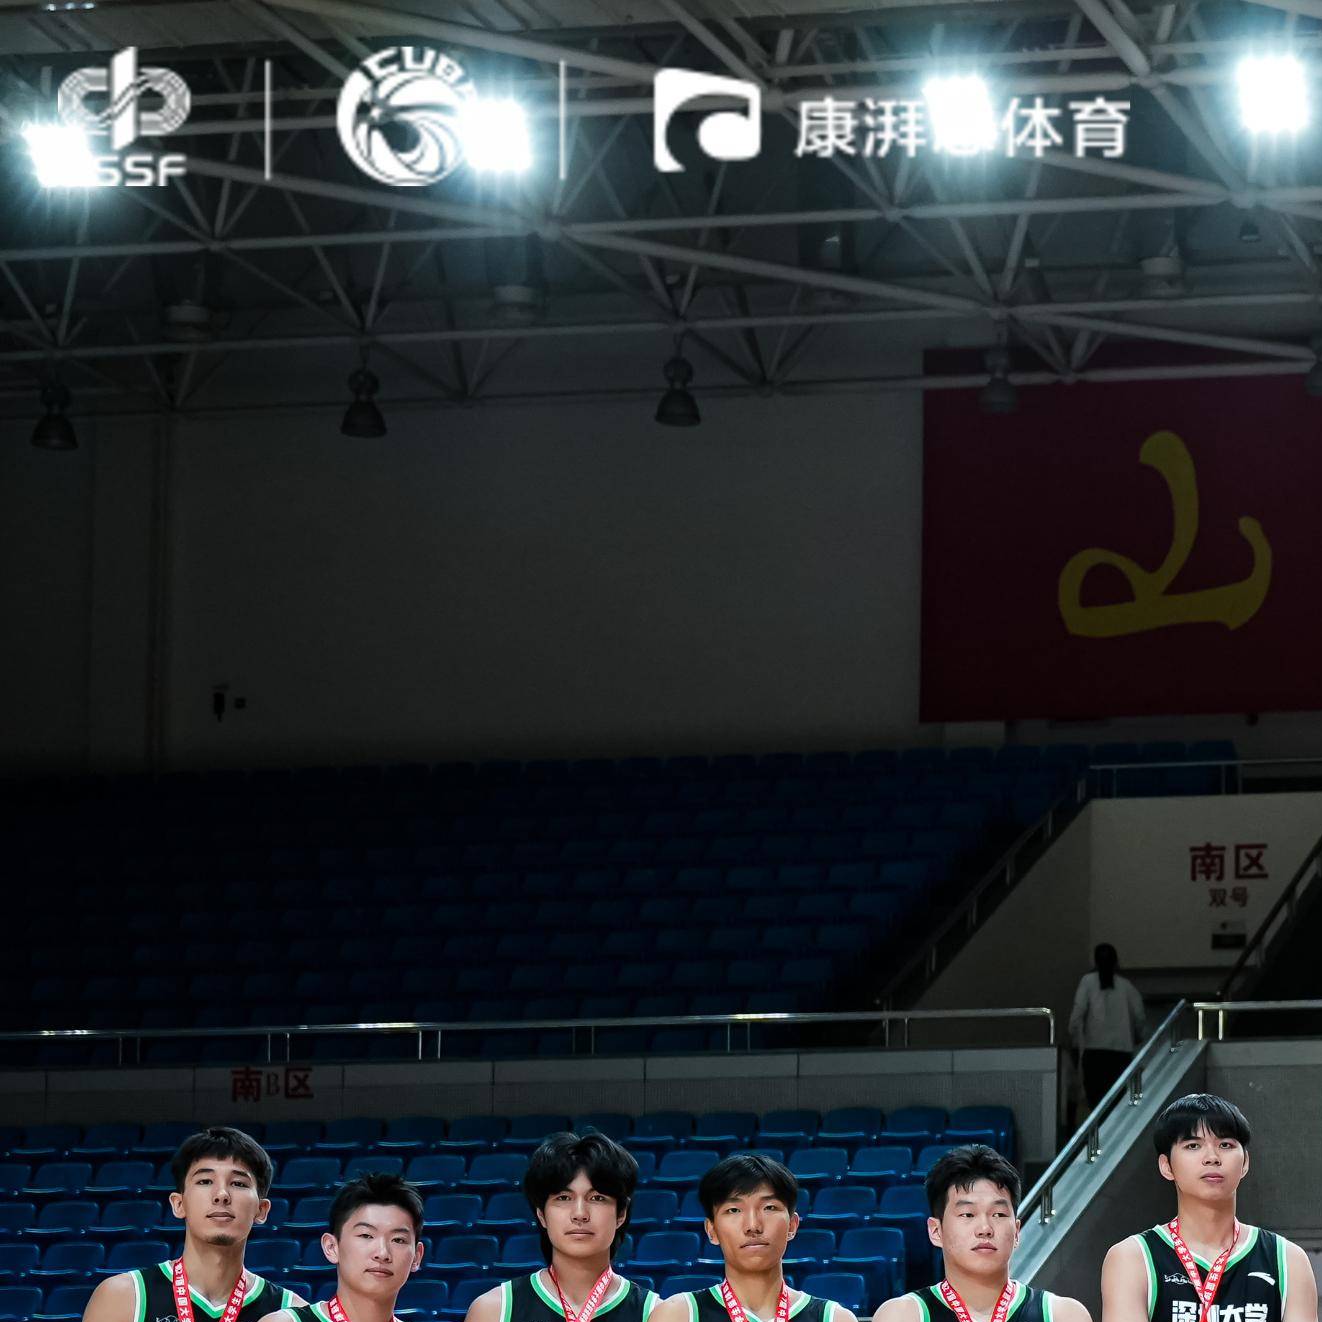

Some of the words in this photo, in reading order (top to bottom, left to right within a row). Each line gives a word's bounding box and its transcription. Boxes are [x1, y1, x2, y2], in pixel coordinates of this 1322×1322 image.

[1189, 842, 1269, 882] 南区
[1208, 887, 1249, 908] 双号
[232, 1066, 314, 1102] 南B区
